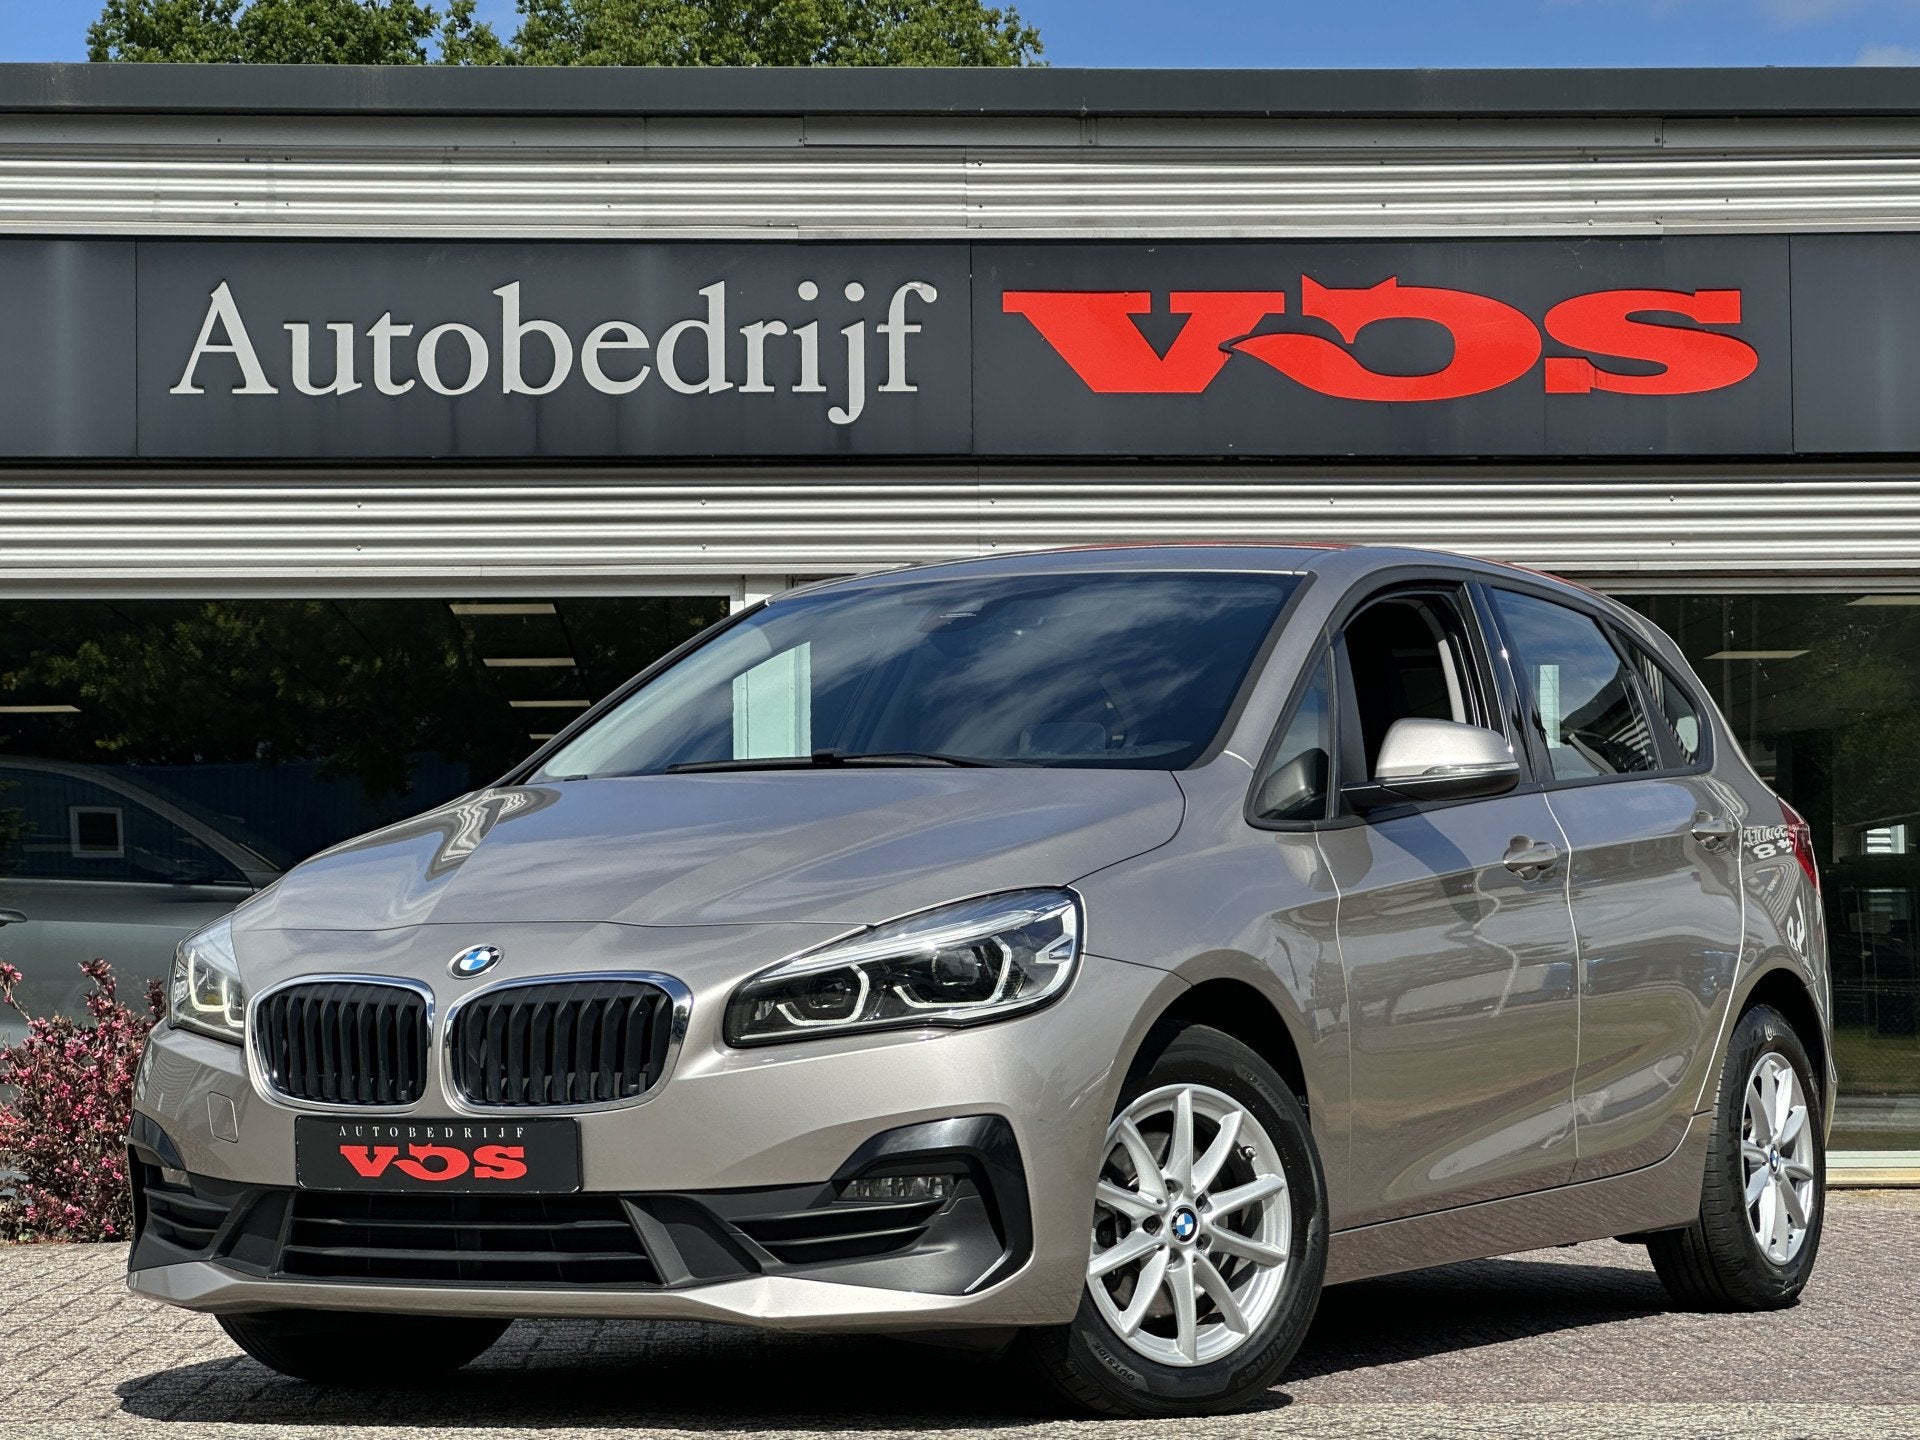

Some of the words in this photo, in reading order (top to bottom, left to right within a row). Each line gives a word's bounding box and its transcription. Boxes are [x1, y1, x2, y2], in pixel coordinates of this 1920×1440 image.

[170, 281, 937, 424] Autobedrijf
[1003, 275, 1758, 401] VOS
[339, 1125, 524, 1138] AUTOBEDRIJF
[339, 1143, 528, 1181] VOS
